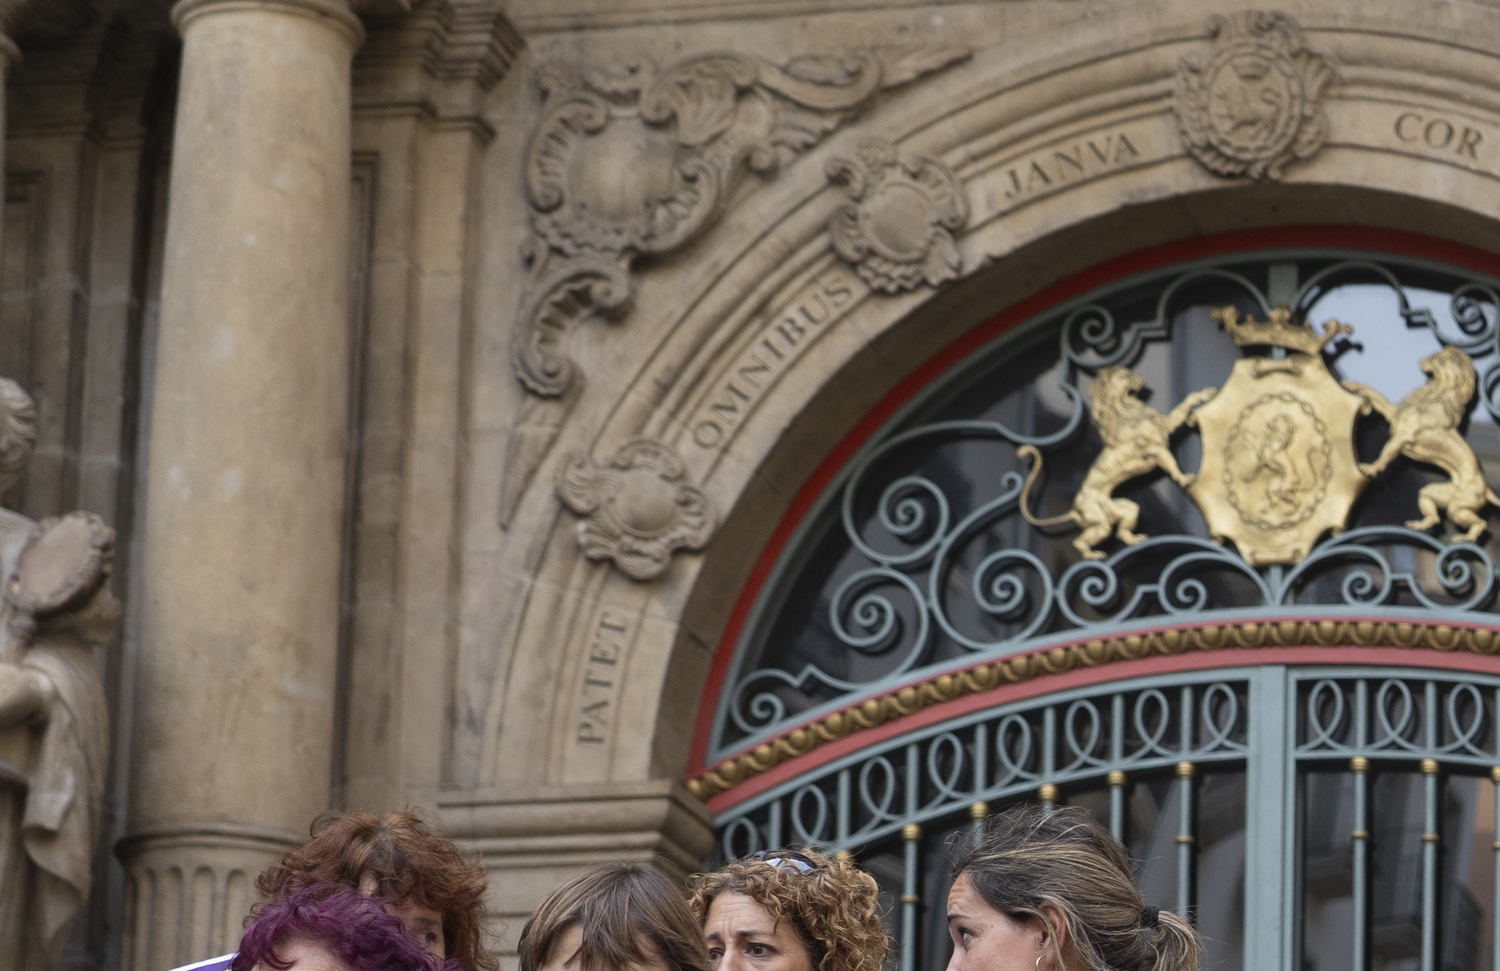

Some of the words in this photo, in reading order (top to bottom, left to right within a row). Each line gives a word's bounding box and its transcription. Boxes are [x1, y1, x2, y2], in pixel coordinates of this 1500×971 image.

[1004, 130, 1142, 199] JANVA
[1393, 112, 1484, 159] COR
[694, 274, 857, 451] OMNIBUS
[577, 608, 629, 747] PATET
